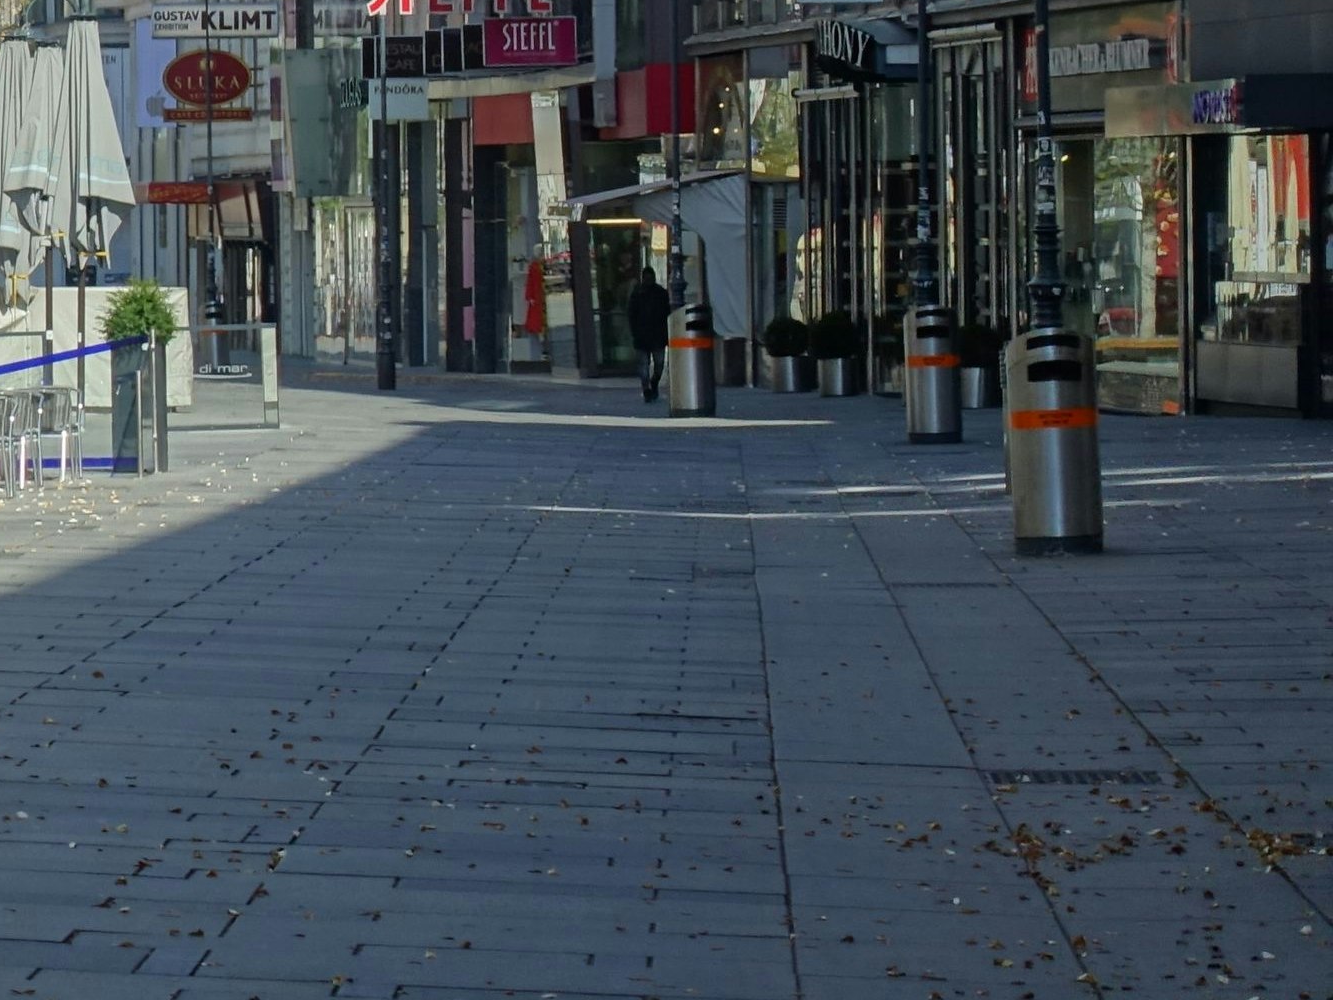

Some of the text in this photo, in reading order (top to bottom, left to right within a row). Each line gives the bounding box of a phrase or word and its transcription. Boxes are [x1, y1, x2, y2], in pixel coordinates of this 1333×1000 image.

[153, 10, 276, 31] GUSTAV KLIMT
[154, 22, 189, 31] EXHIBITION
[502, 20, 556, 51] STEFFL
[174, 75, 242, 90] SLUKA
[374, 83, 424, 95] PNDORA
